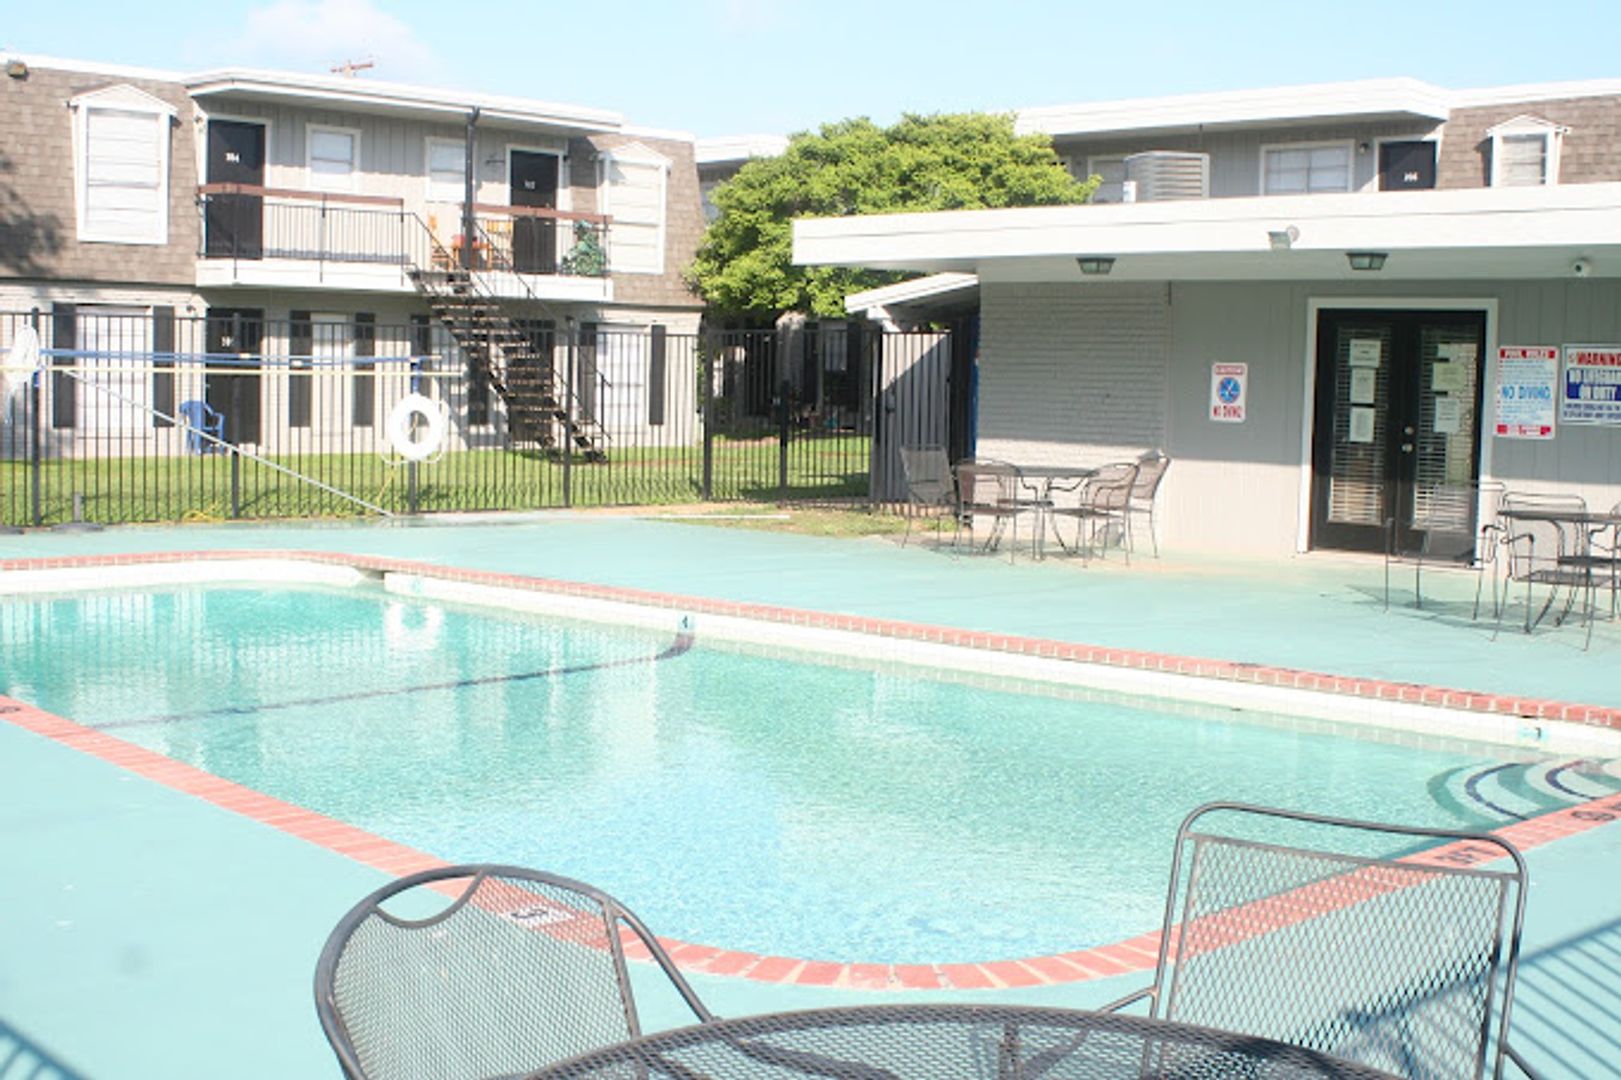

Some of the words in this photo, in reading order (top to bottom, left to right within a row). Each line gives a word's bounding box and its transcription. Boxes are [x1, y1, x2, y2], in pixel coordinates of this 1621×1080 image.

[1502, 386, 1515, 399] NO
[1519, 386, 1551, 399] DIVING
[1213, 405, 1222, 417] NO
[1223, 405, 1243, 418] DIVING
